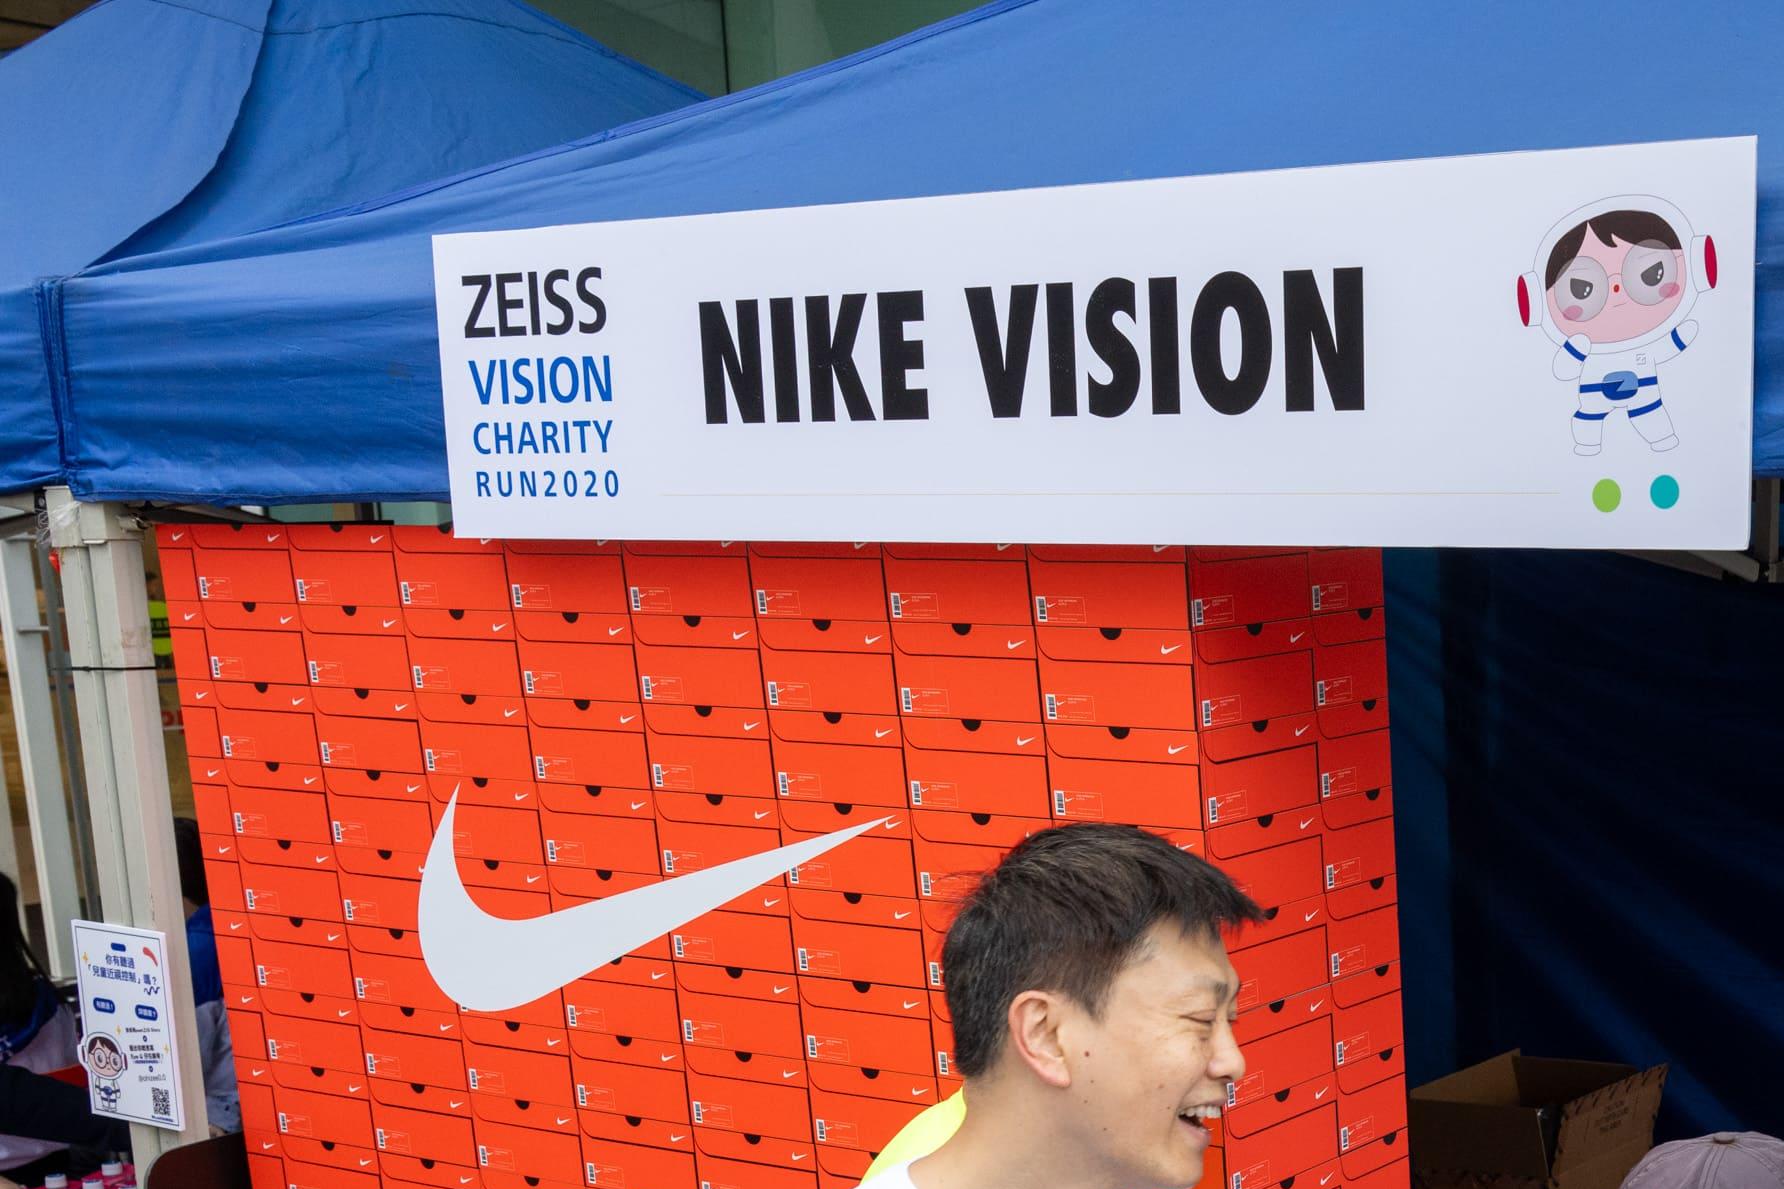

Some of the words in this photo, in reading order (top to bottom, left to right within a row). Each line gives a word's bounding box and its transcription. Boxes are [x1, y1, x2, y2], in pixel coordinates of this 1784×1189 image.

[461, 266, 607, 339] ZEISS
[698, 289, 930, 425] NIKE
[964, 266, 1367, 420] VISION
[467, 355, 613, 405] VISION
[473, 419, 613, 454] CHARITY
[476, 470, 619, 497] RUN2020
